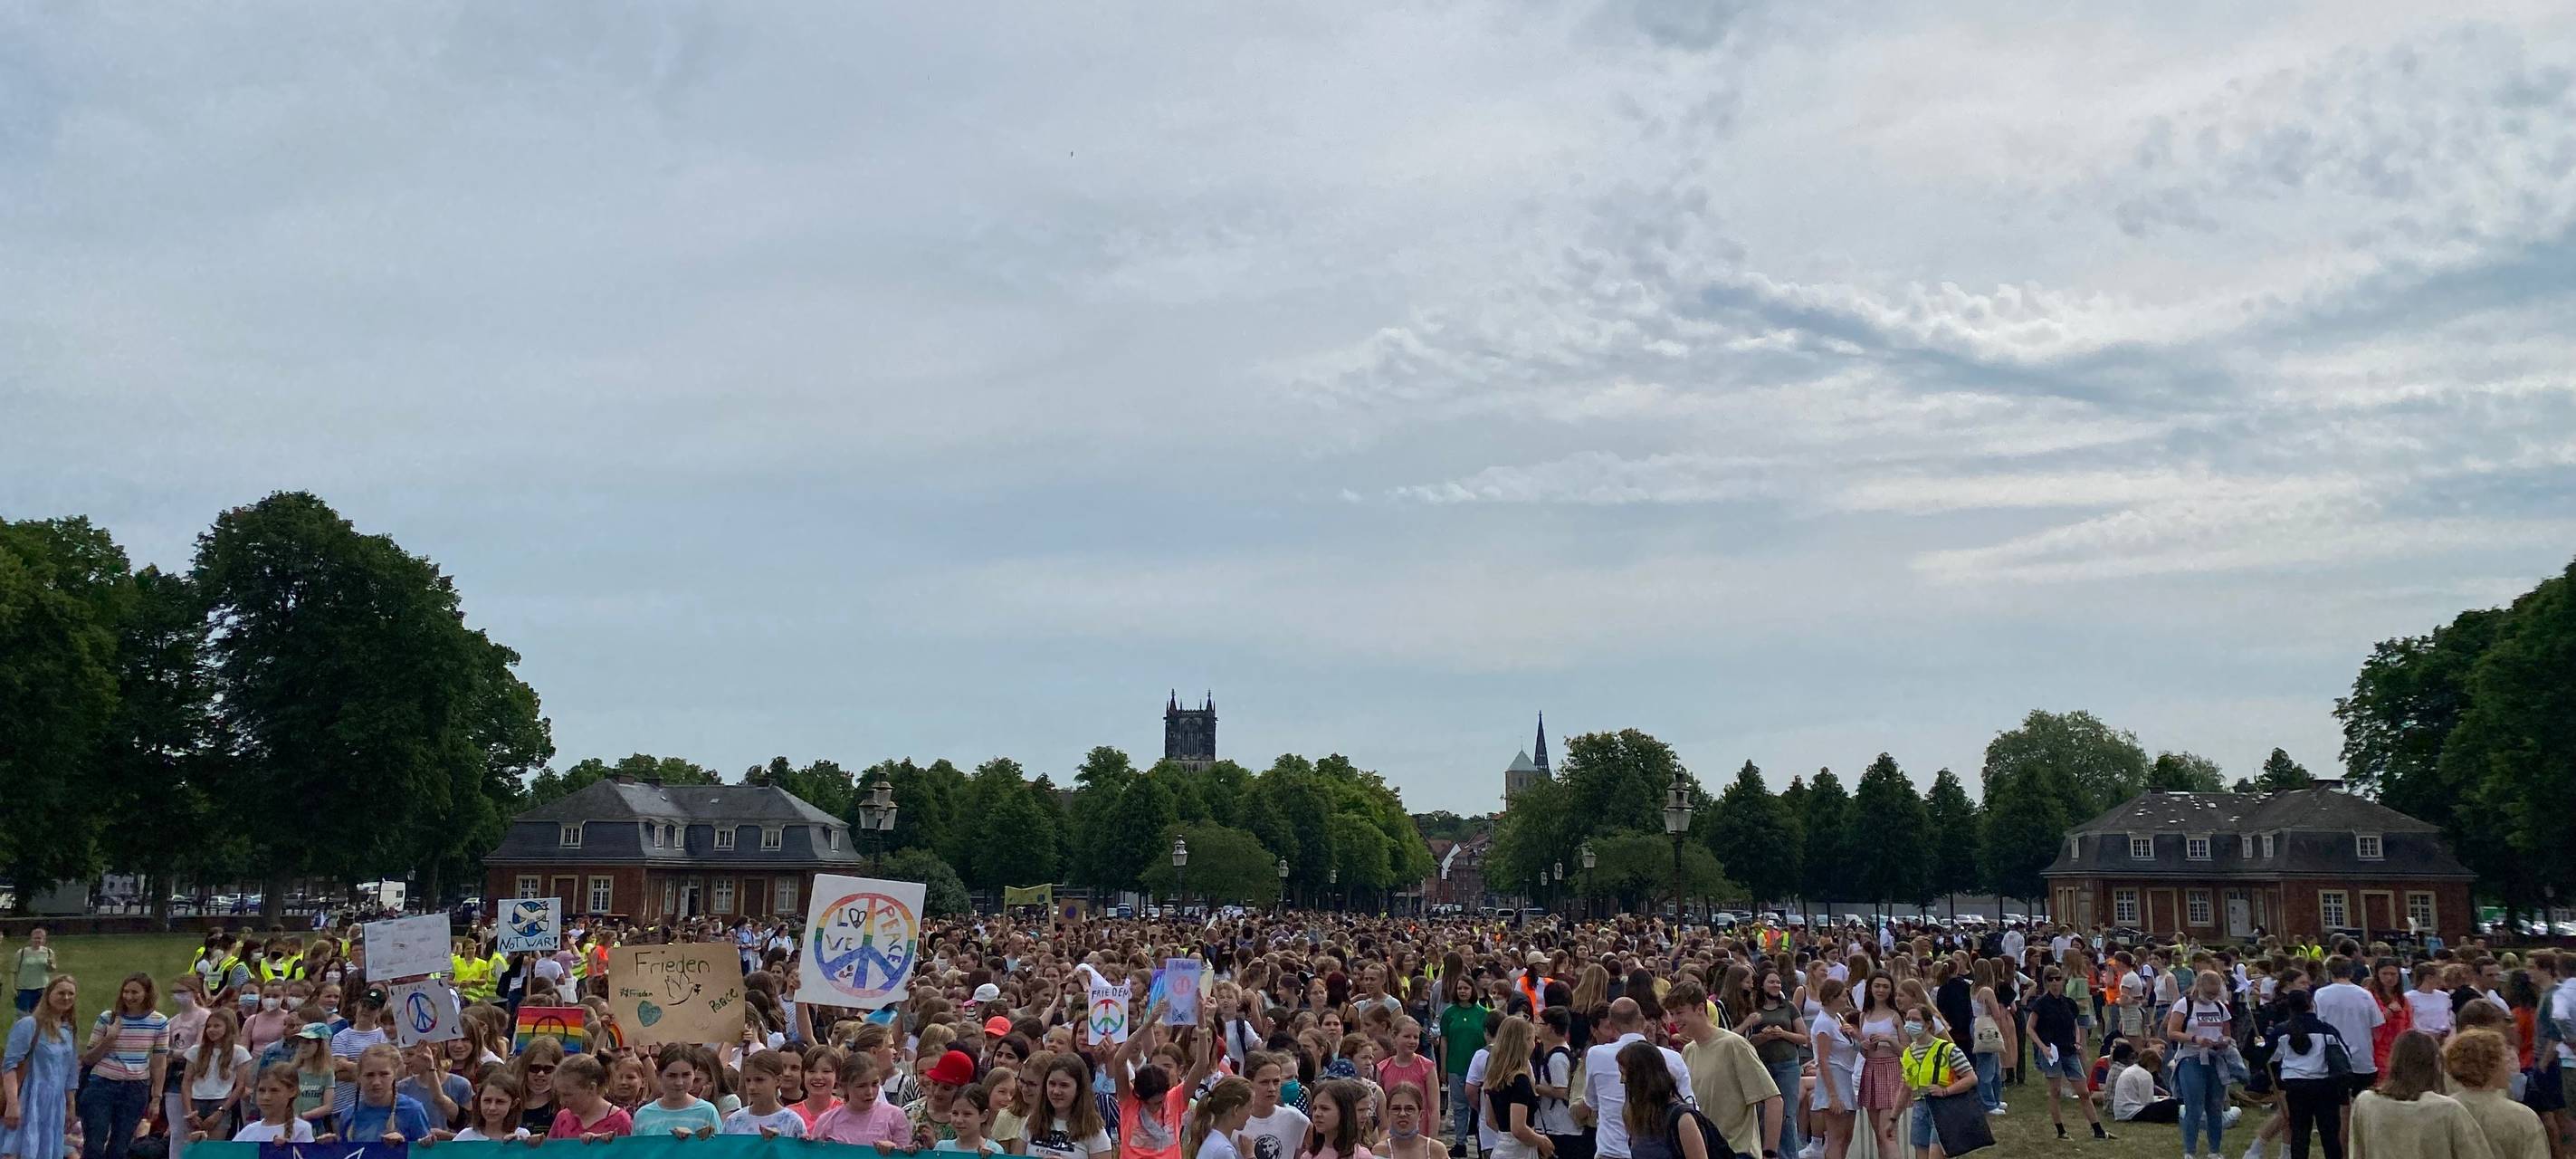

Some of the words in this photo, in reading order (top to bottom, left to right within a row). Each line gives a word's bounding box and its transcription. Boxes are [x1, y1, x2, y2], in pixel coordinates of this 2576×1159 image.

[525, 936, 558, 949] WAR!
[876, 905, 903, 963] PEACE
[634, 951, 711, 976] Frieden
[1092, 987, 1129, 1000] FRIEDEN
